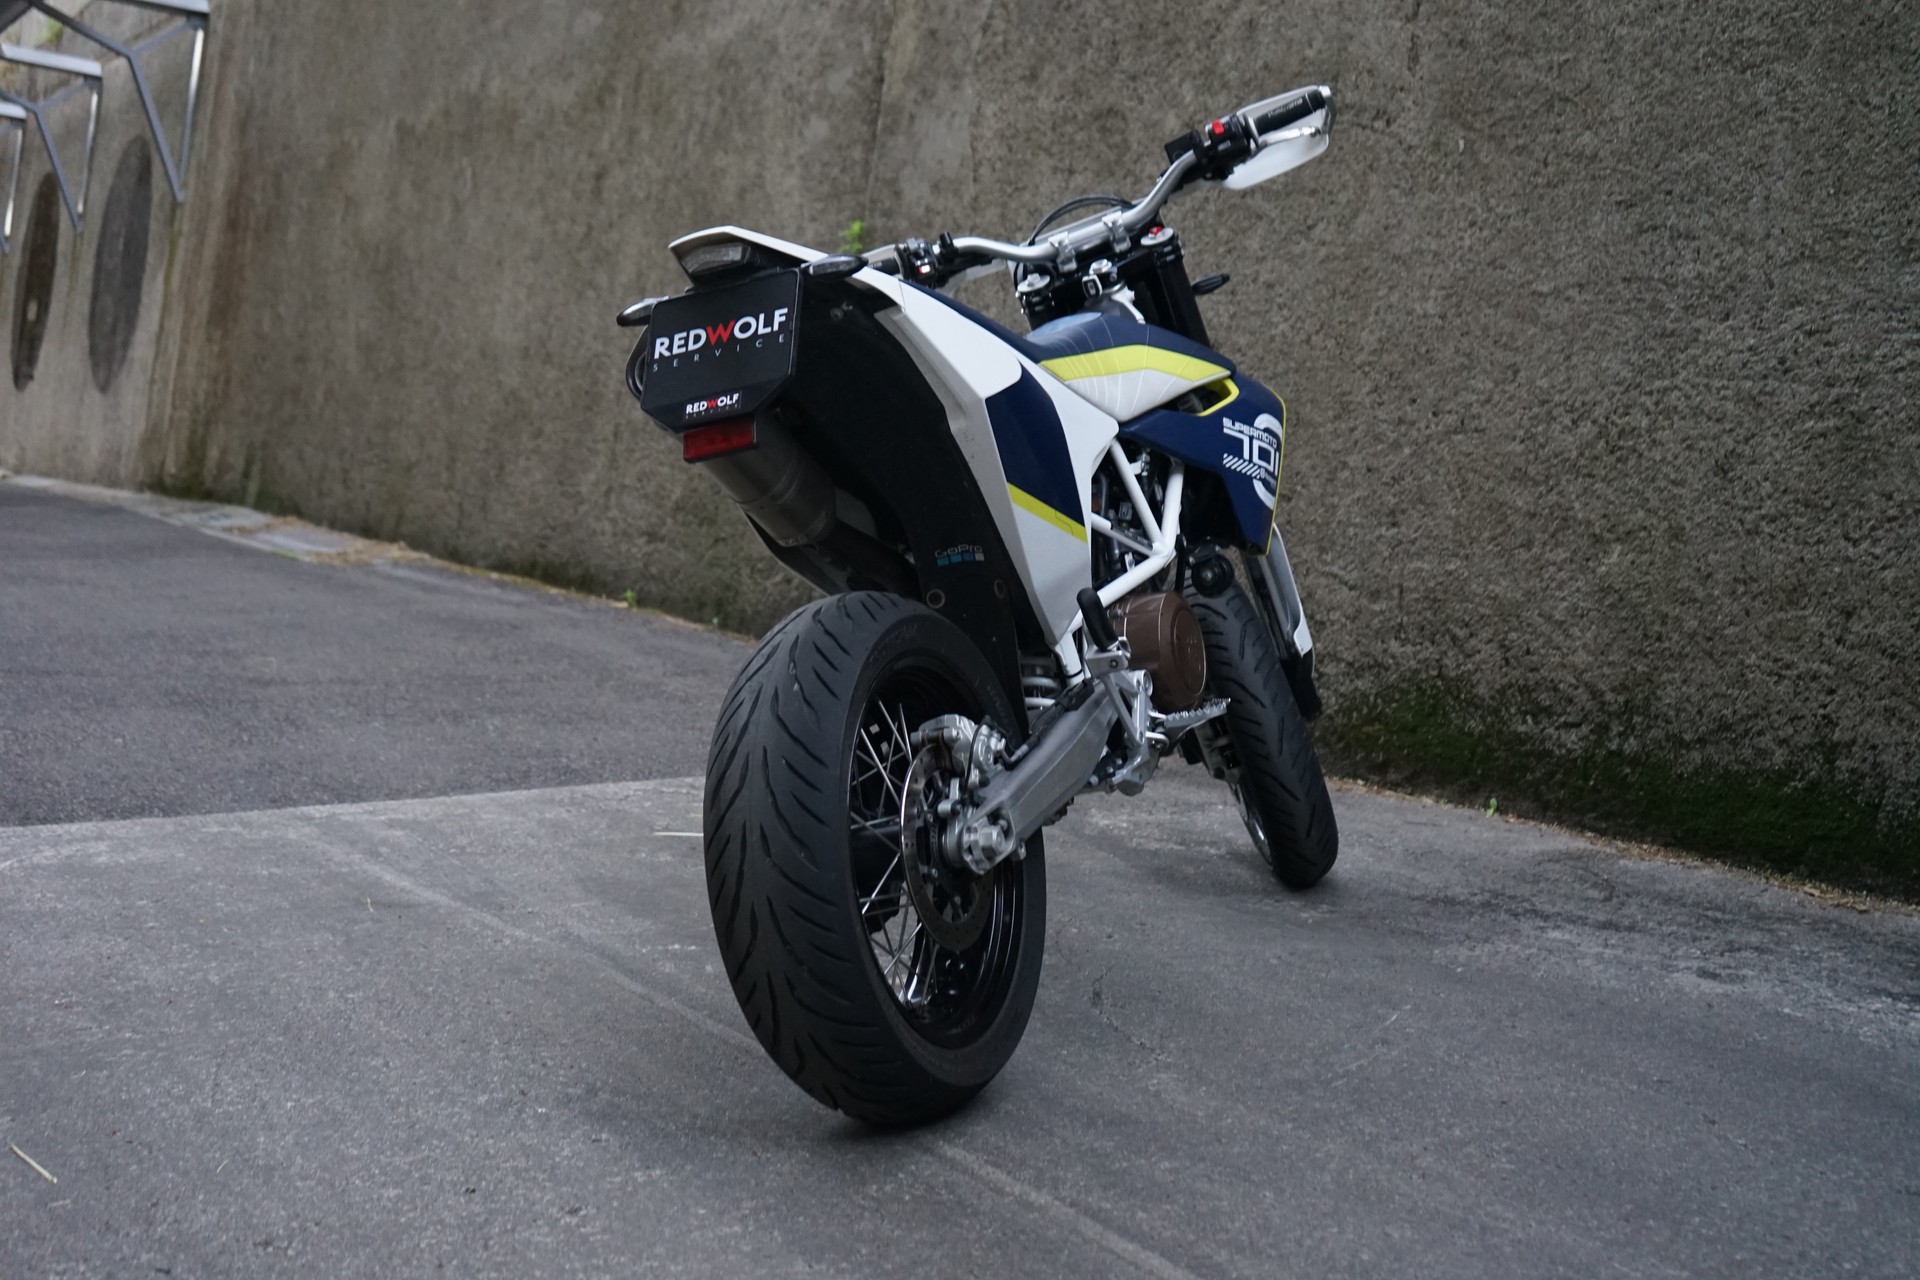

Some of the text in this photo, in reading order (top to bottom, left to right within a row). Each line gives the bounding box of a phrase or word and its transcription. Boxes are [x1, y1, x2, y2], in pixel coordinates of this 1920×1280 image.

[653, 307, 788, 360] REDWOLF
[653, 334, 785, 372] SERVICE
[686, 393, 739, 414] REDWOLF
[1222, 416, 1277, 449] SUPERMOTO
